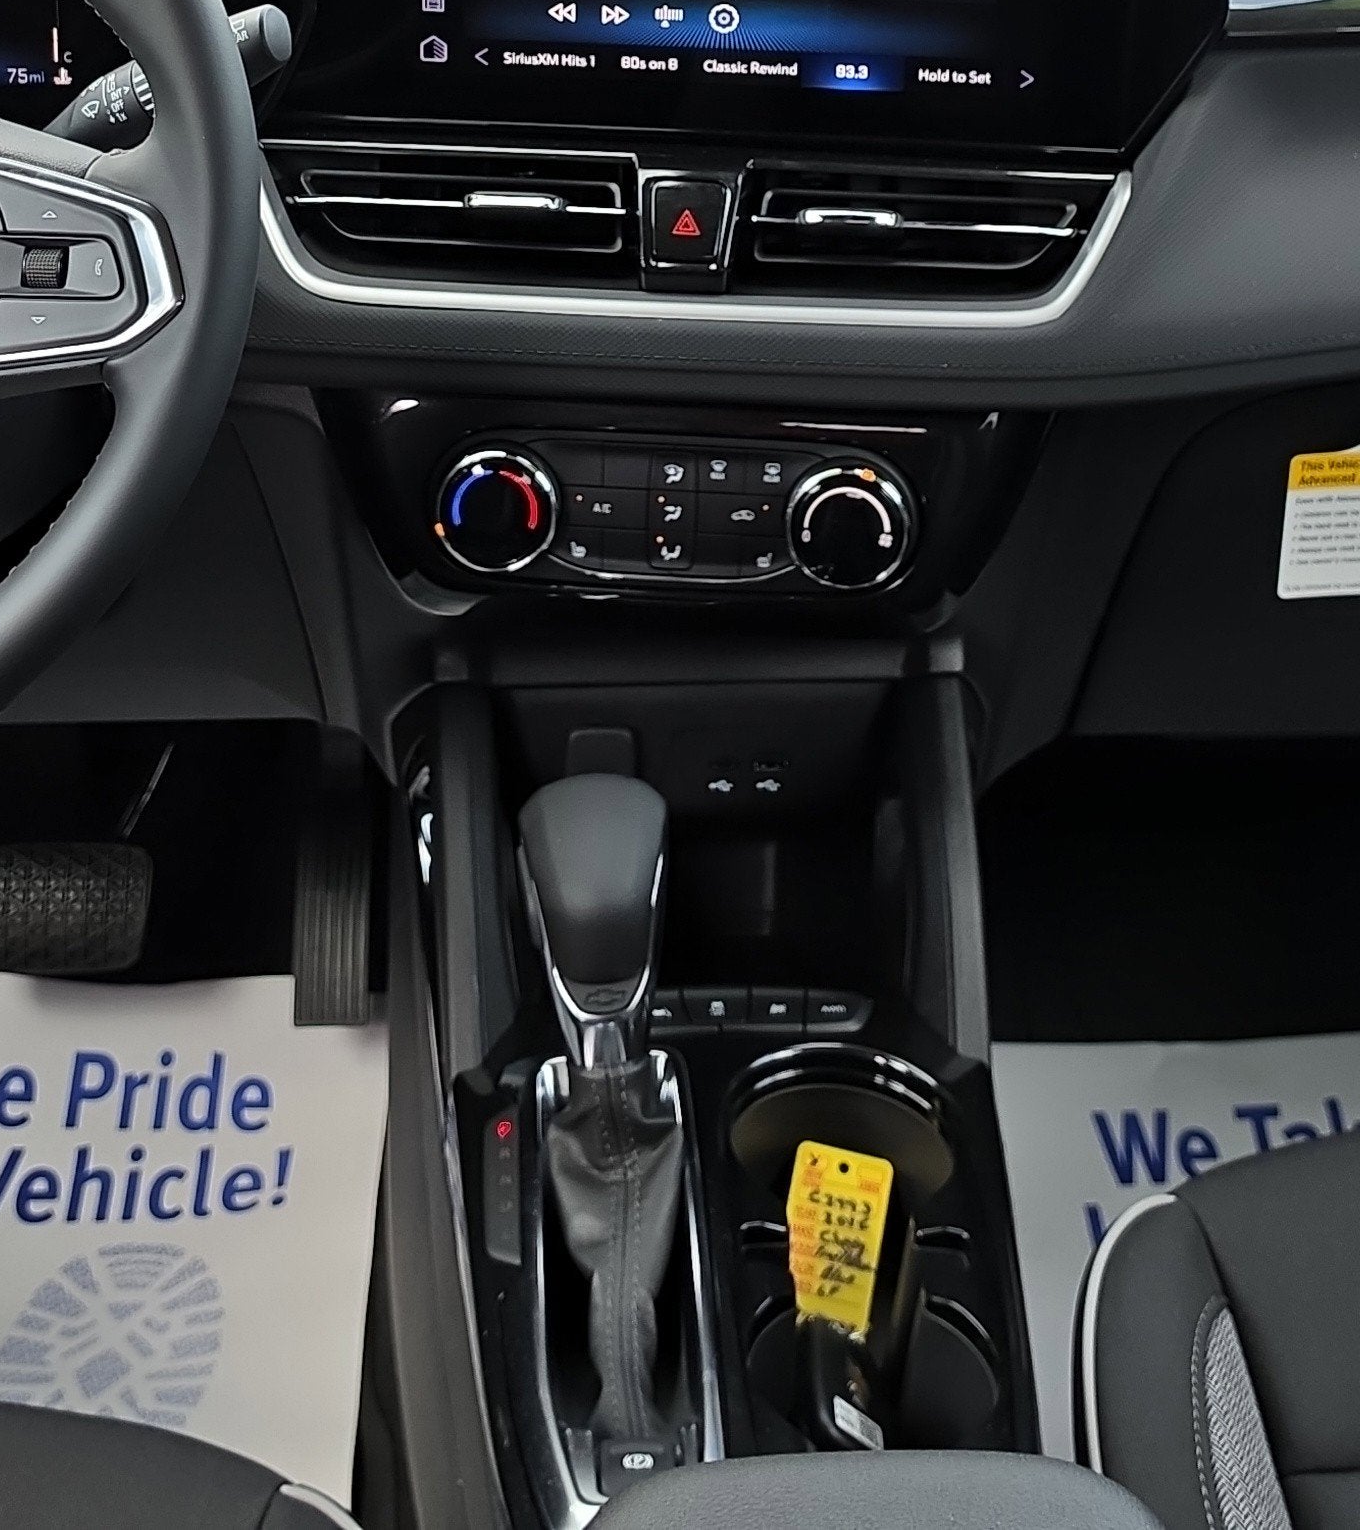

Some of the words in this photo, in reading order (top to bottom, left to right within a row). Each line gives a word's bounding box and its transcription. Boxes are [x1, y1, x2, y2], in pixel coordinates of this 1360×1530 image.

[63, 51, 73, 64] C
[502, 51, 560, 68] SiriusXM
[561, 53, 587, 68] Hits
[620, 56, 647, 71] 80s
[648, 59, 666, 71] on
[702, 59, 749, 75] Classic
[750, 61, 798, 76] Rewind
[917, 68, 950, 84] Hold
[951, 70, 967, 85] to
[968, 70, 992, 86] Set
[110, 99, 125, 113] OFF
[64, 1050, 275, 1133] Pride
[1090, 1107, 1219, 1186] We
